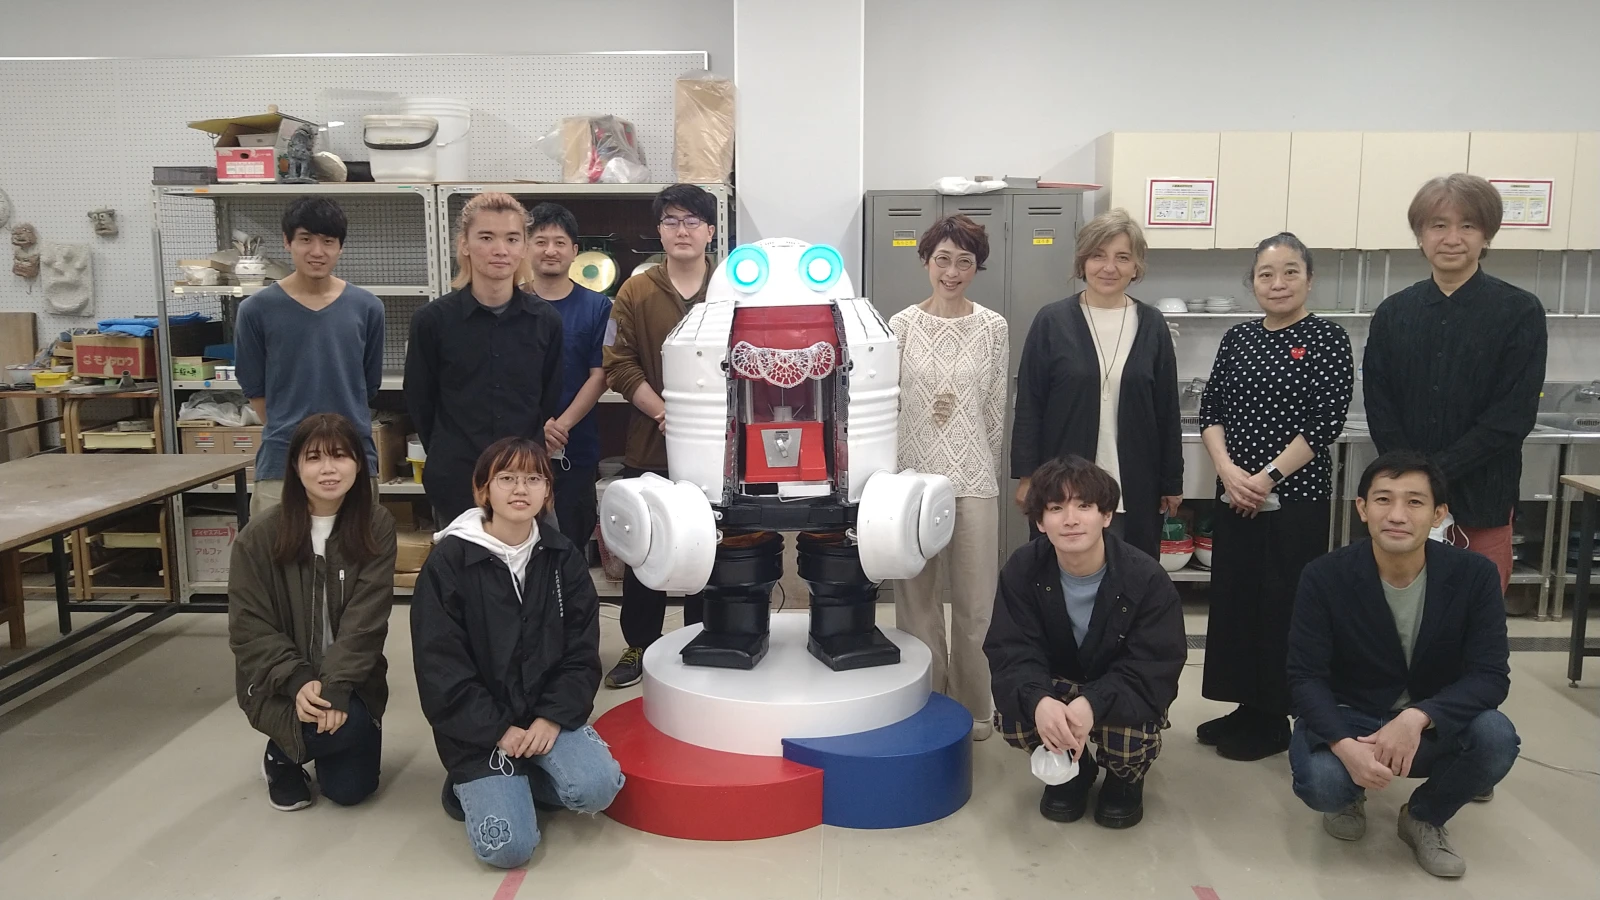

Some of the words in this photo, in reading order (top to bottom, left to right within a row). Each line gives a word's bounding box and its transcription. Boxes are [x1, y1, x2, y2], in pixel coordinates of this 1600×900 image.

[94, 355, 134, 366] モノタロウ
[195, 547, 222, 555] アルファ
